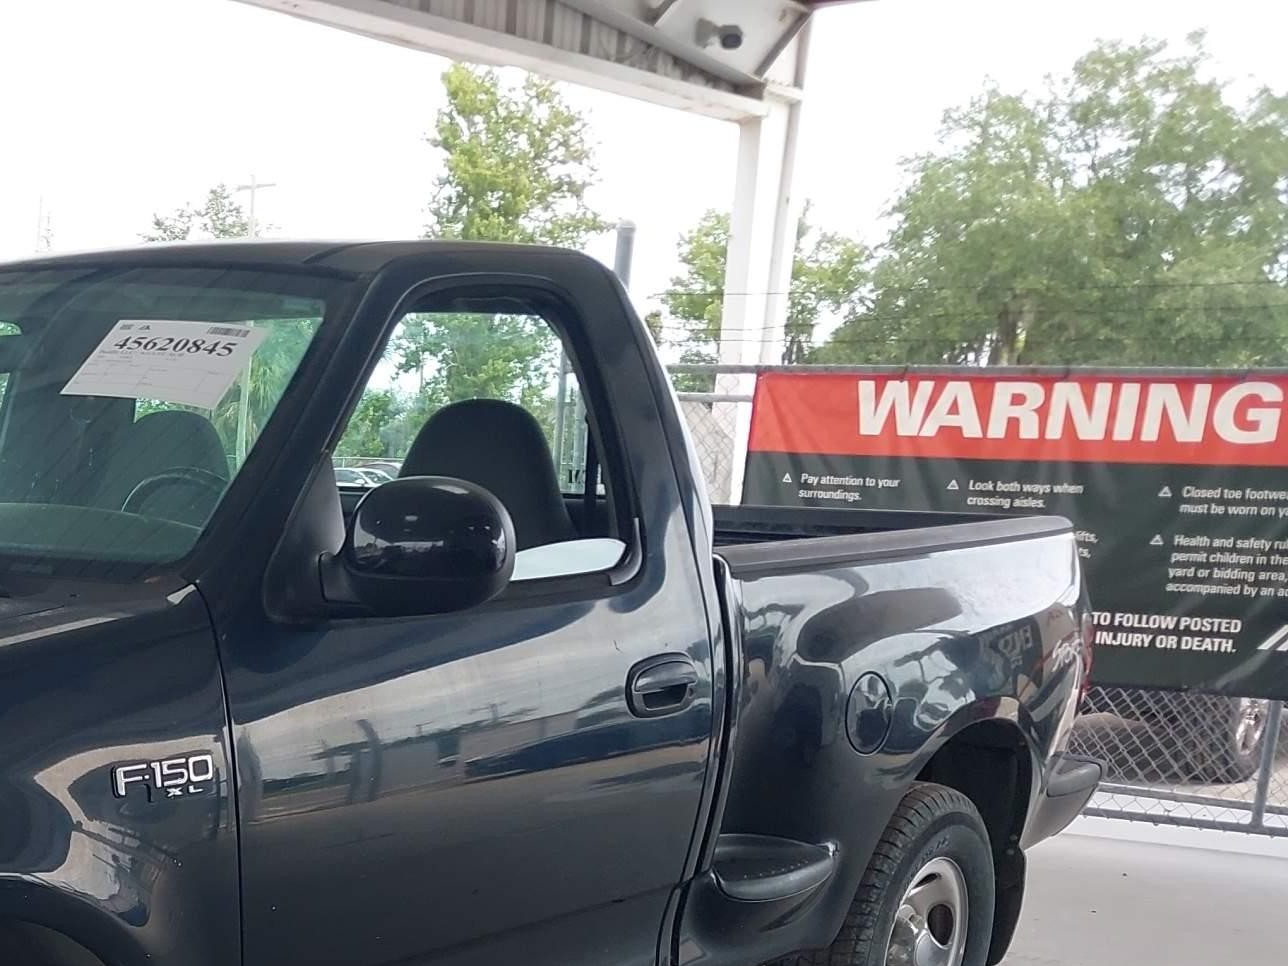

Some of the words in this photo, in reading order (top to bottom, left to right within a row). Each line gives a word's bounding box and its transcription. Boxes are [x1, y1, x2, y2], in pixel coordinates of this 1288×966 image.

[114, 336, 239, 357] 45620845
[857, 380, 1284, 445] WARNING
[801, 473, 819, 486] Pay
[820, 475, 863, 487] attention
[866, 477, 875, 487] to
[878, 479, 900, 489] your
[969, 479, 994, 491] Look
[996, 481, 1020, 492] both
[1022, 483, 1050, 494] ways
[1053, 483, 1083, 494] when
[799, 489, 862, 501] surroundings.
[1182, 486, 1221, 498] Closed
[1223, 489, 1242, 499] toe
[967, 496, 1011, 509] crossing
[1013, 497, 1046, 508] aisles.
[1179, 503, 1208, 513] must
[1210, 503, 1225, 514] be
[1227, 506, 1257, 515] worn
[1260, 507, 1275, 515] on
[1174, 535, 1210, 547] Health
[1212, 537, 1233, 547] and
[1236, 537, 1272, 551] safety
[1171, 551, 1207, 563] permit
[1209, 552, 1253, 564] children
[1256, 554, 1267, 564] in
[1270, 554, 1288, 565] the
[1168, 567, 1195, 578] yard
[1197, 569, 1210, 578] or
[1213, 568, 1255, 582] bidding
[1259, 571, 1287, 582] area,
[1165, 583, 1240, 596] accompanied
[1243, 584, 1258, 597] by
[1260, 587, 1274, 596] an
[1092, 611, 1111, 625] TO
[1114, 612, 1178, 630] FOLLOW
[1179, 617, 1242, 633] POSTED
[1095, 631, 1155, 648] INJURY
[1156, 635, 1178, 649] OR
[1181, 636, 1237, 653] DEATH.
[166, 785, 203, 797] XL
